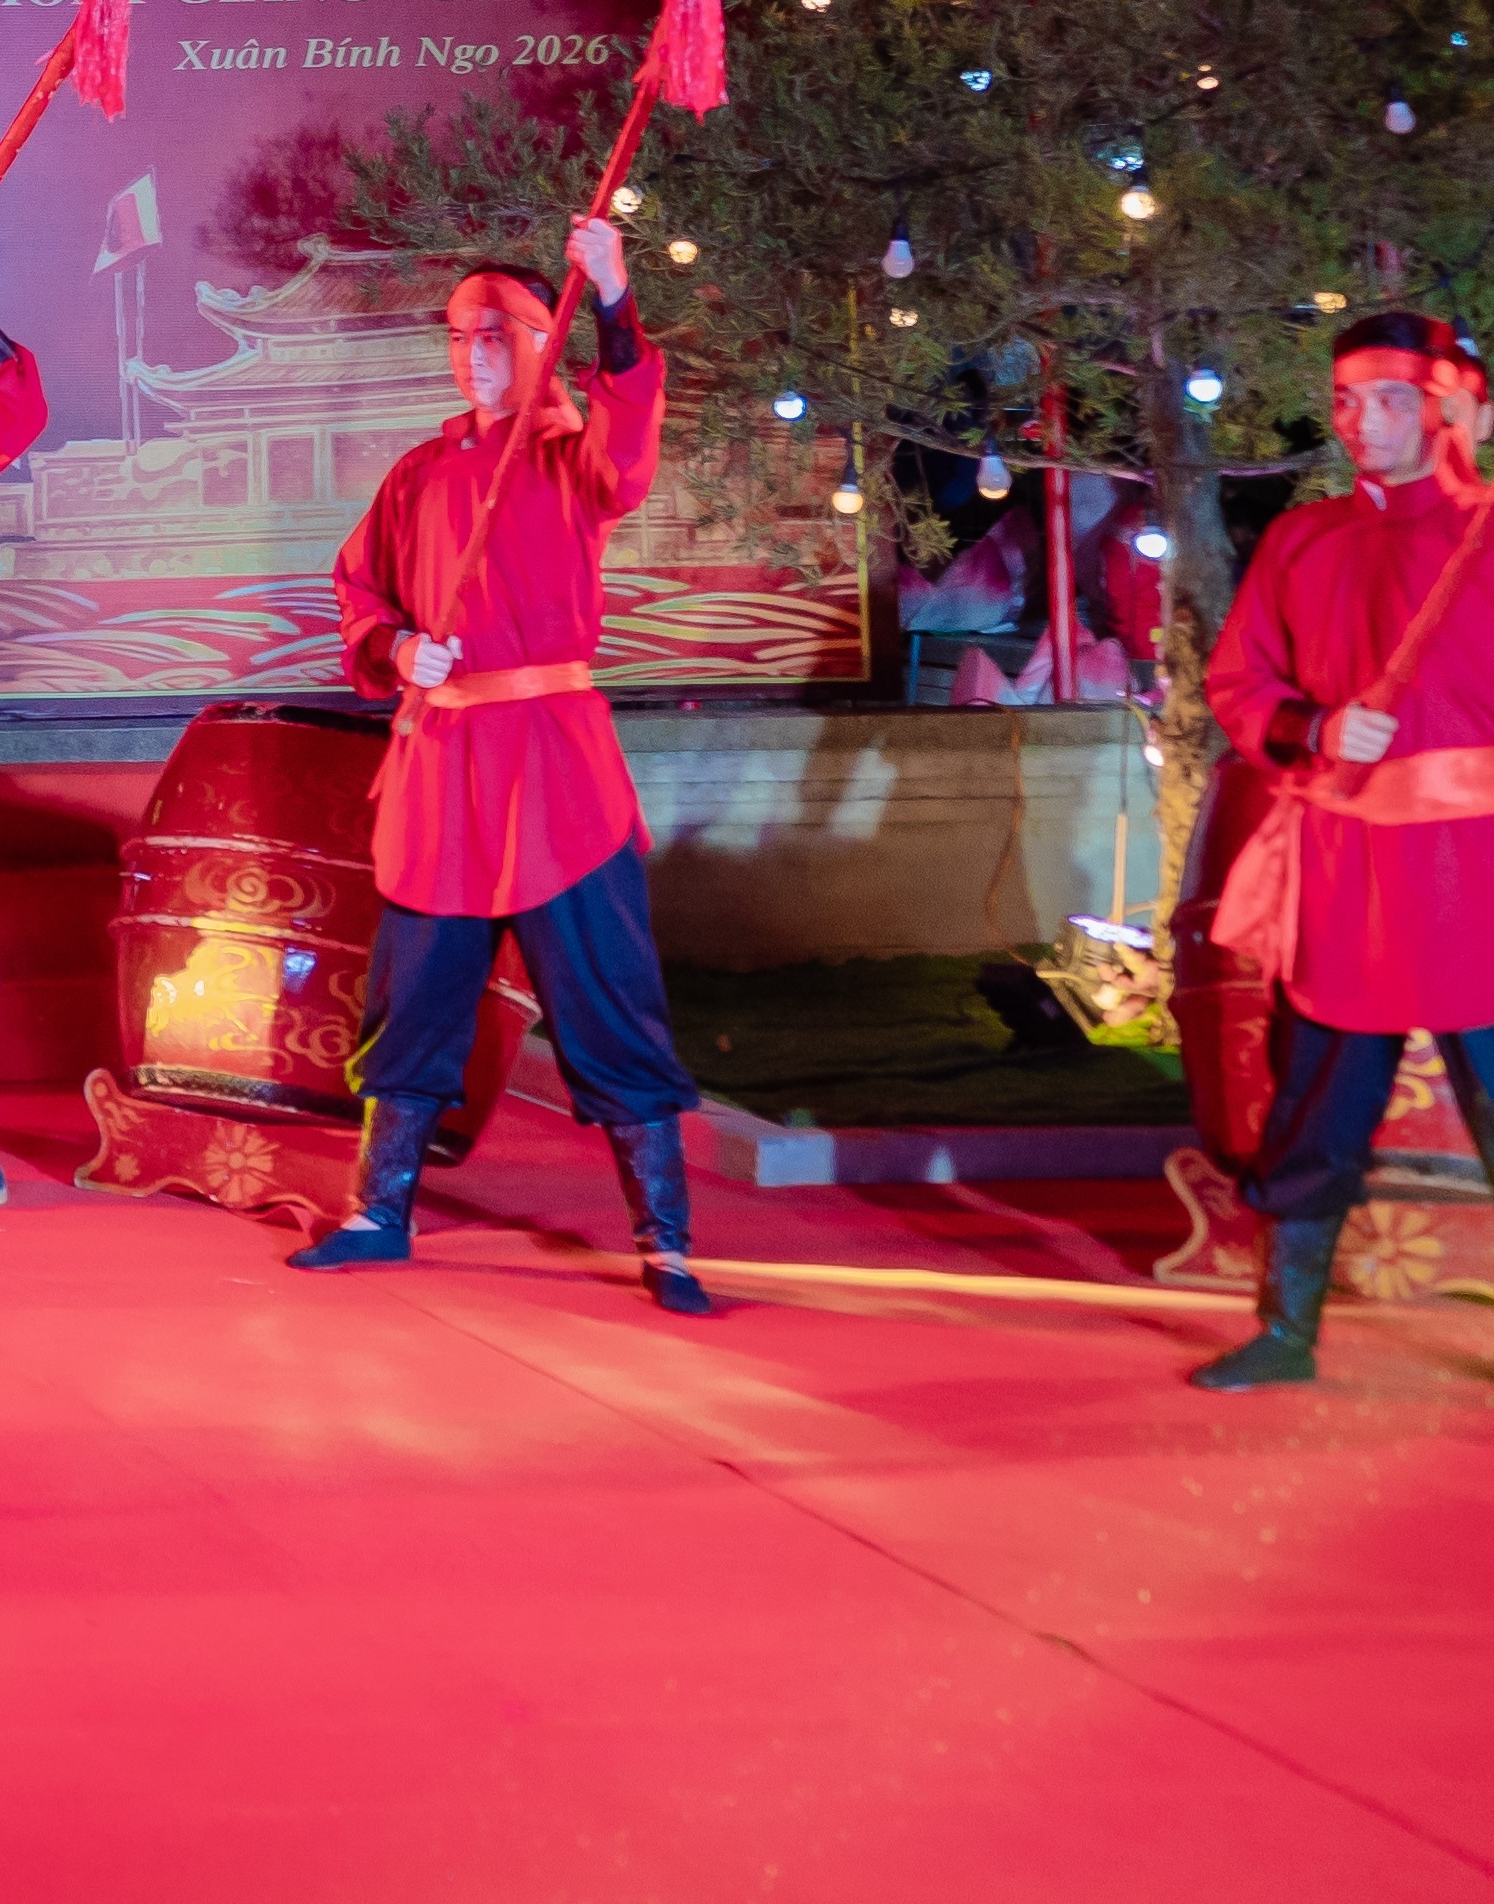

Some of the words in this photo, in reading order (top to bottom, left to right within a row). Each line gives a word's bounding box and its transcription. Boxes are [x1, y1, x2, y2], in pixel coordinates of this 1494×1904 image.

[173, 38, 287, 71] Xuân
[302, 36, 401, 68] Bính
[511, 34, 609, 66] 2026
